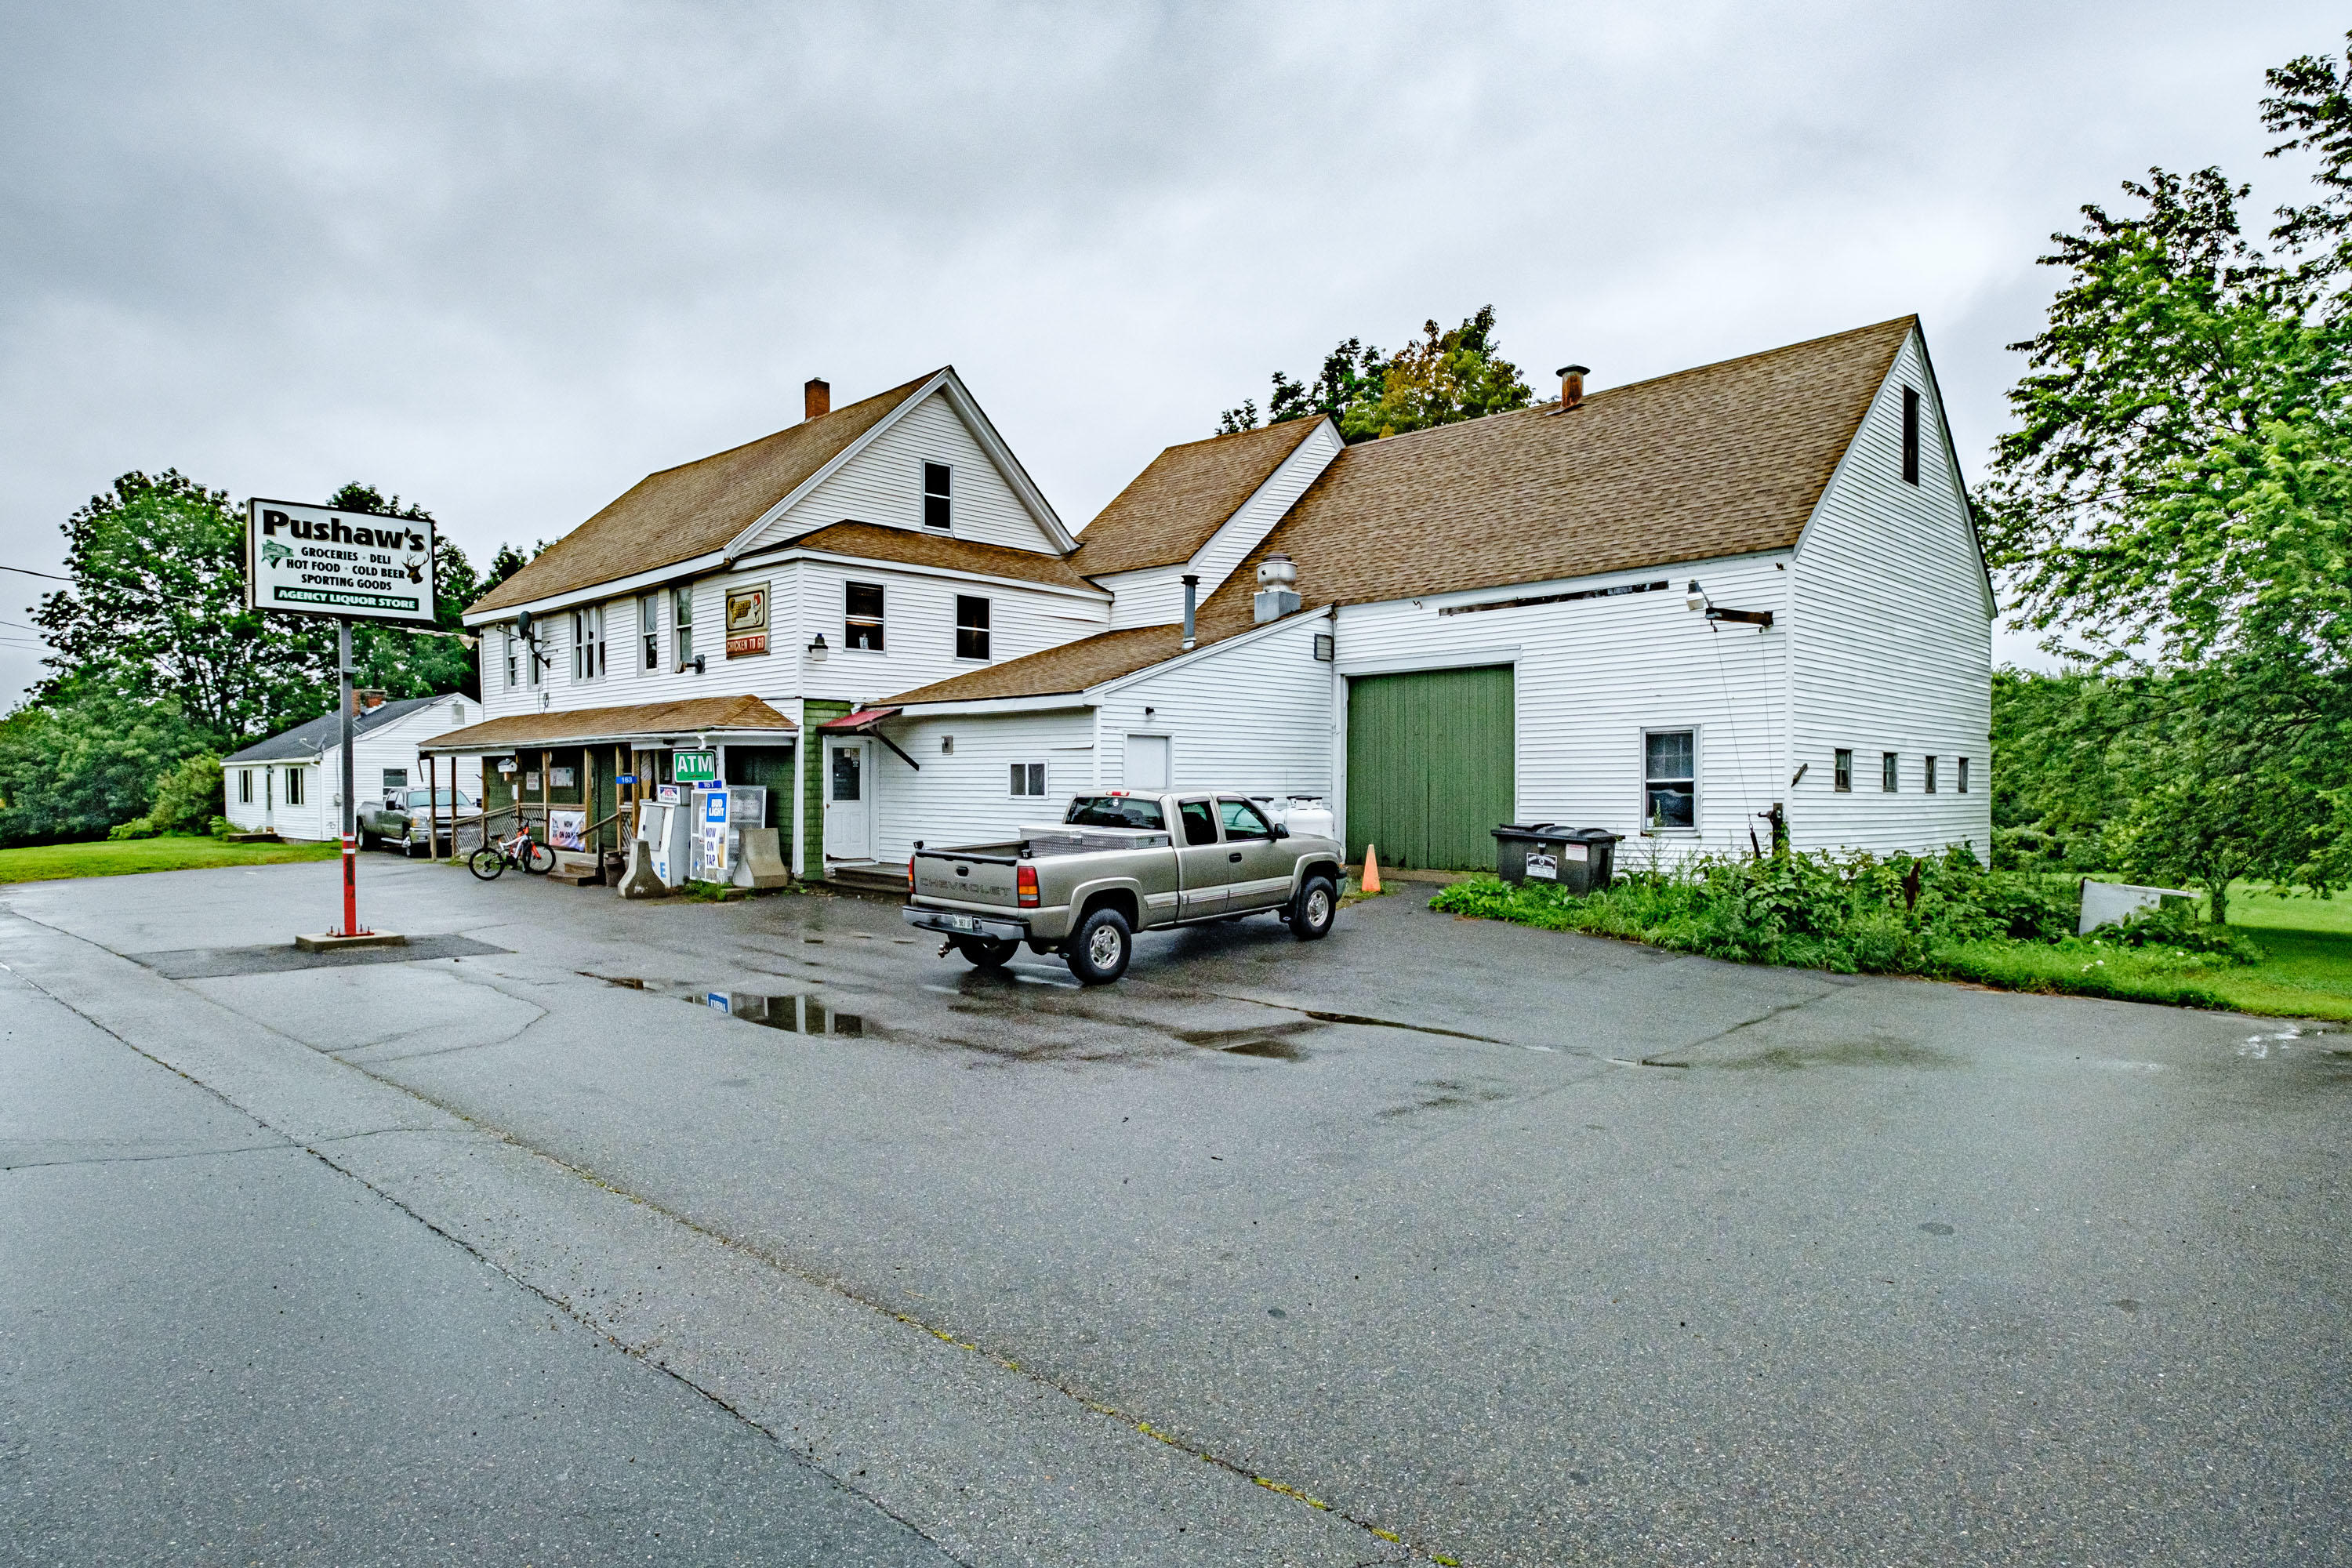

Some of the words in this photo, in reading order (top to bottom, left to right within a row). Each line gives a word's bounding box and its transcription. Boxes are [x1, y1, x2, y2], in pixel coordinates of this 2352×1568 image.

[263, 509, 425, 552] Pushaw's
[301, 546, 358, 561] GROCERIES
[370, 554, 391, 565] DELI
[286, 559, 308, 570] HOT
[311, 561, 341, 573] FOOD
[352, 564, 378, 576] COLD
[381, 568, 405, 579] BEER
[301, 574, 354, 588] SPORTING
[358, 579, 392, 591] GOODS
[278, 590, 328, 602] AGENCY
[329, 593, 376, 606] LIQUOR
[378, 597, 416, 609] STORE
[727, 640, 748, 652] CHICKEN
[749, 638, 755, 649] TO
[757, 637, 764, 649] GO
[677, 755, 713, 773] ATM
[711, 798, 723, 808] BUD
[709, 807, 724, 817] LIGHT
[706, 827, 716, 838] NOW
[706, 840, 714, 851] ON
[706, 854, 716, 866] TAP
[920, 877, 1011, 896] CHEVROLET
